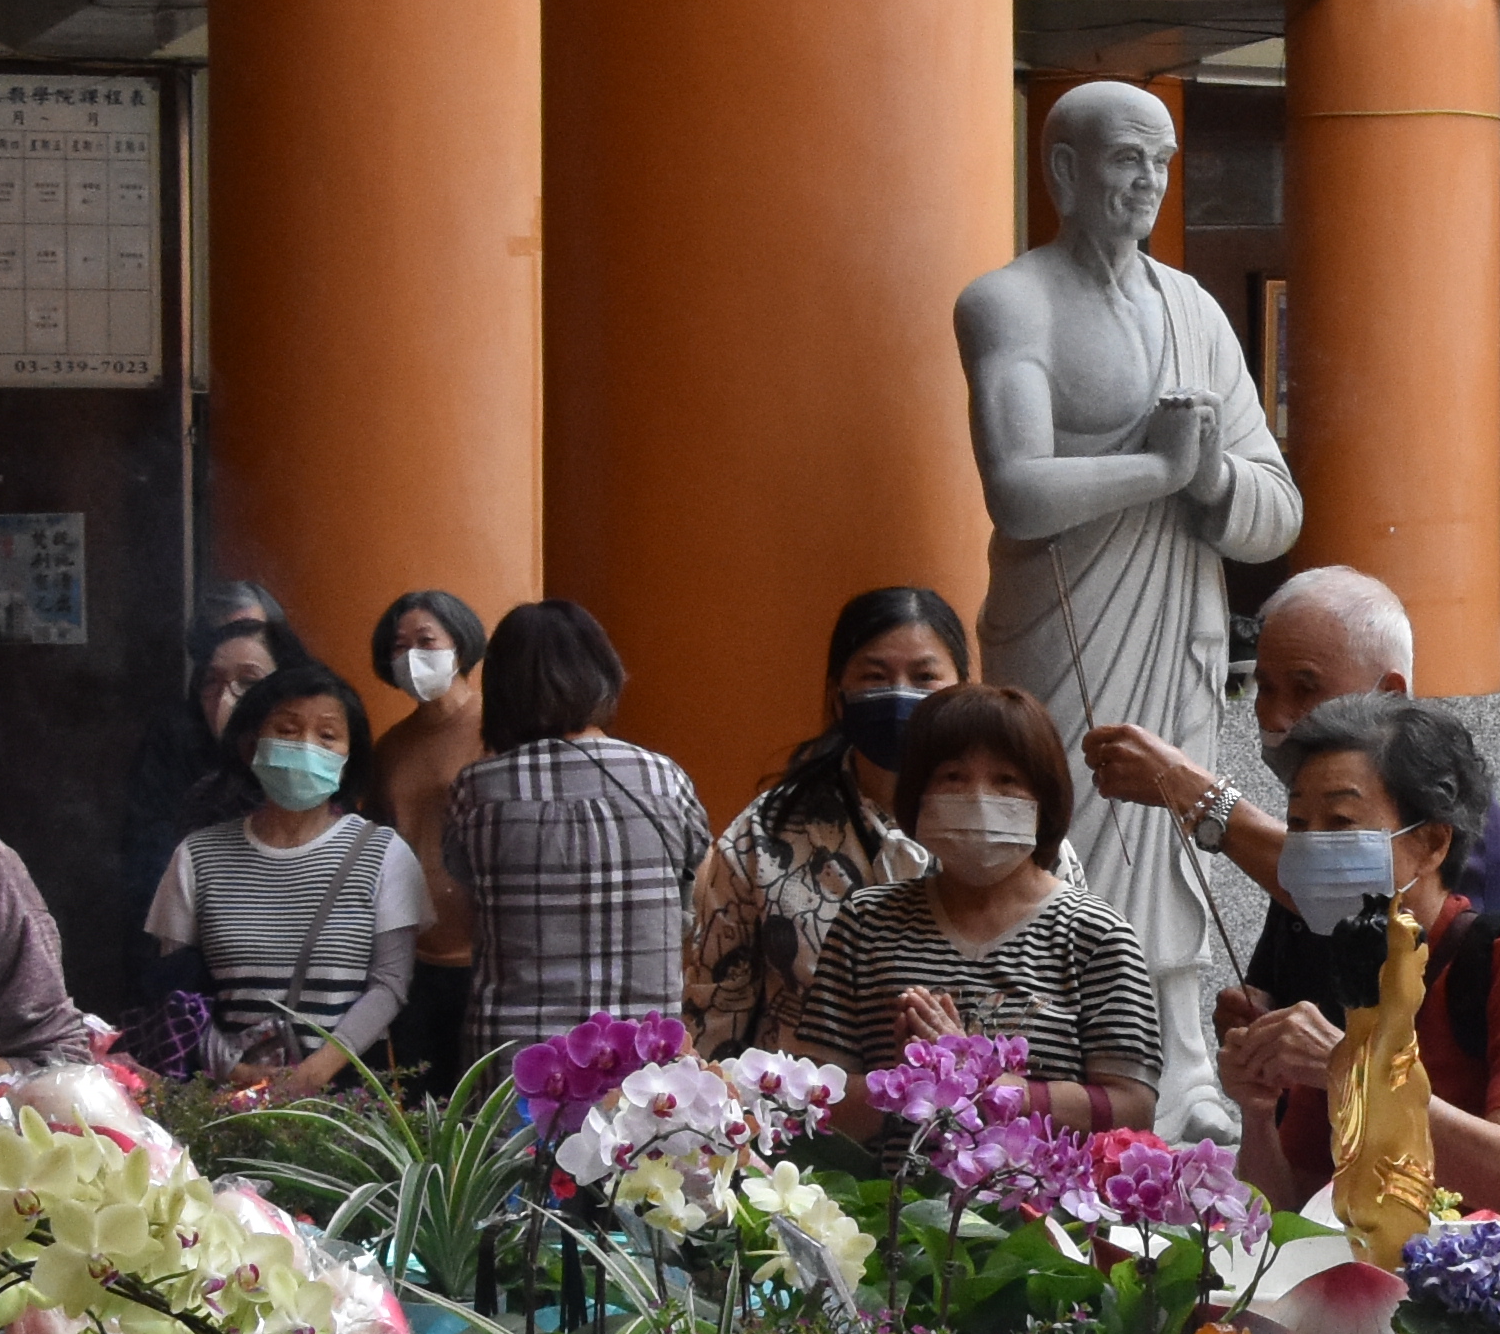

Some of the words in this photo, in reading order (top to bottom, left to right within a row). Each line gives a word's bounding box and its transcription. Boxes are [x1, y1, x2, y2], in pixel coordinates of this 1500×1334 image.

[12, 110, 26, 126] 月
[87, 112, 100, 127] 月
[14, 359, 150, 375] 03-339-7023
